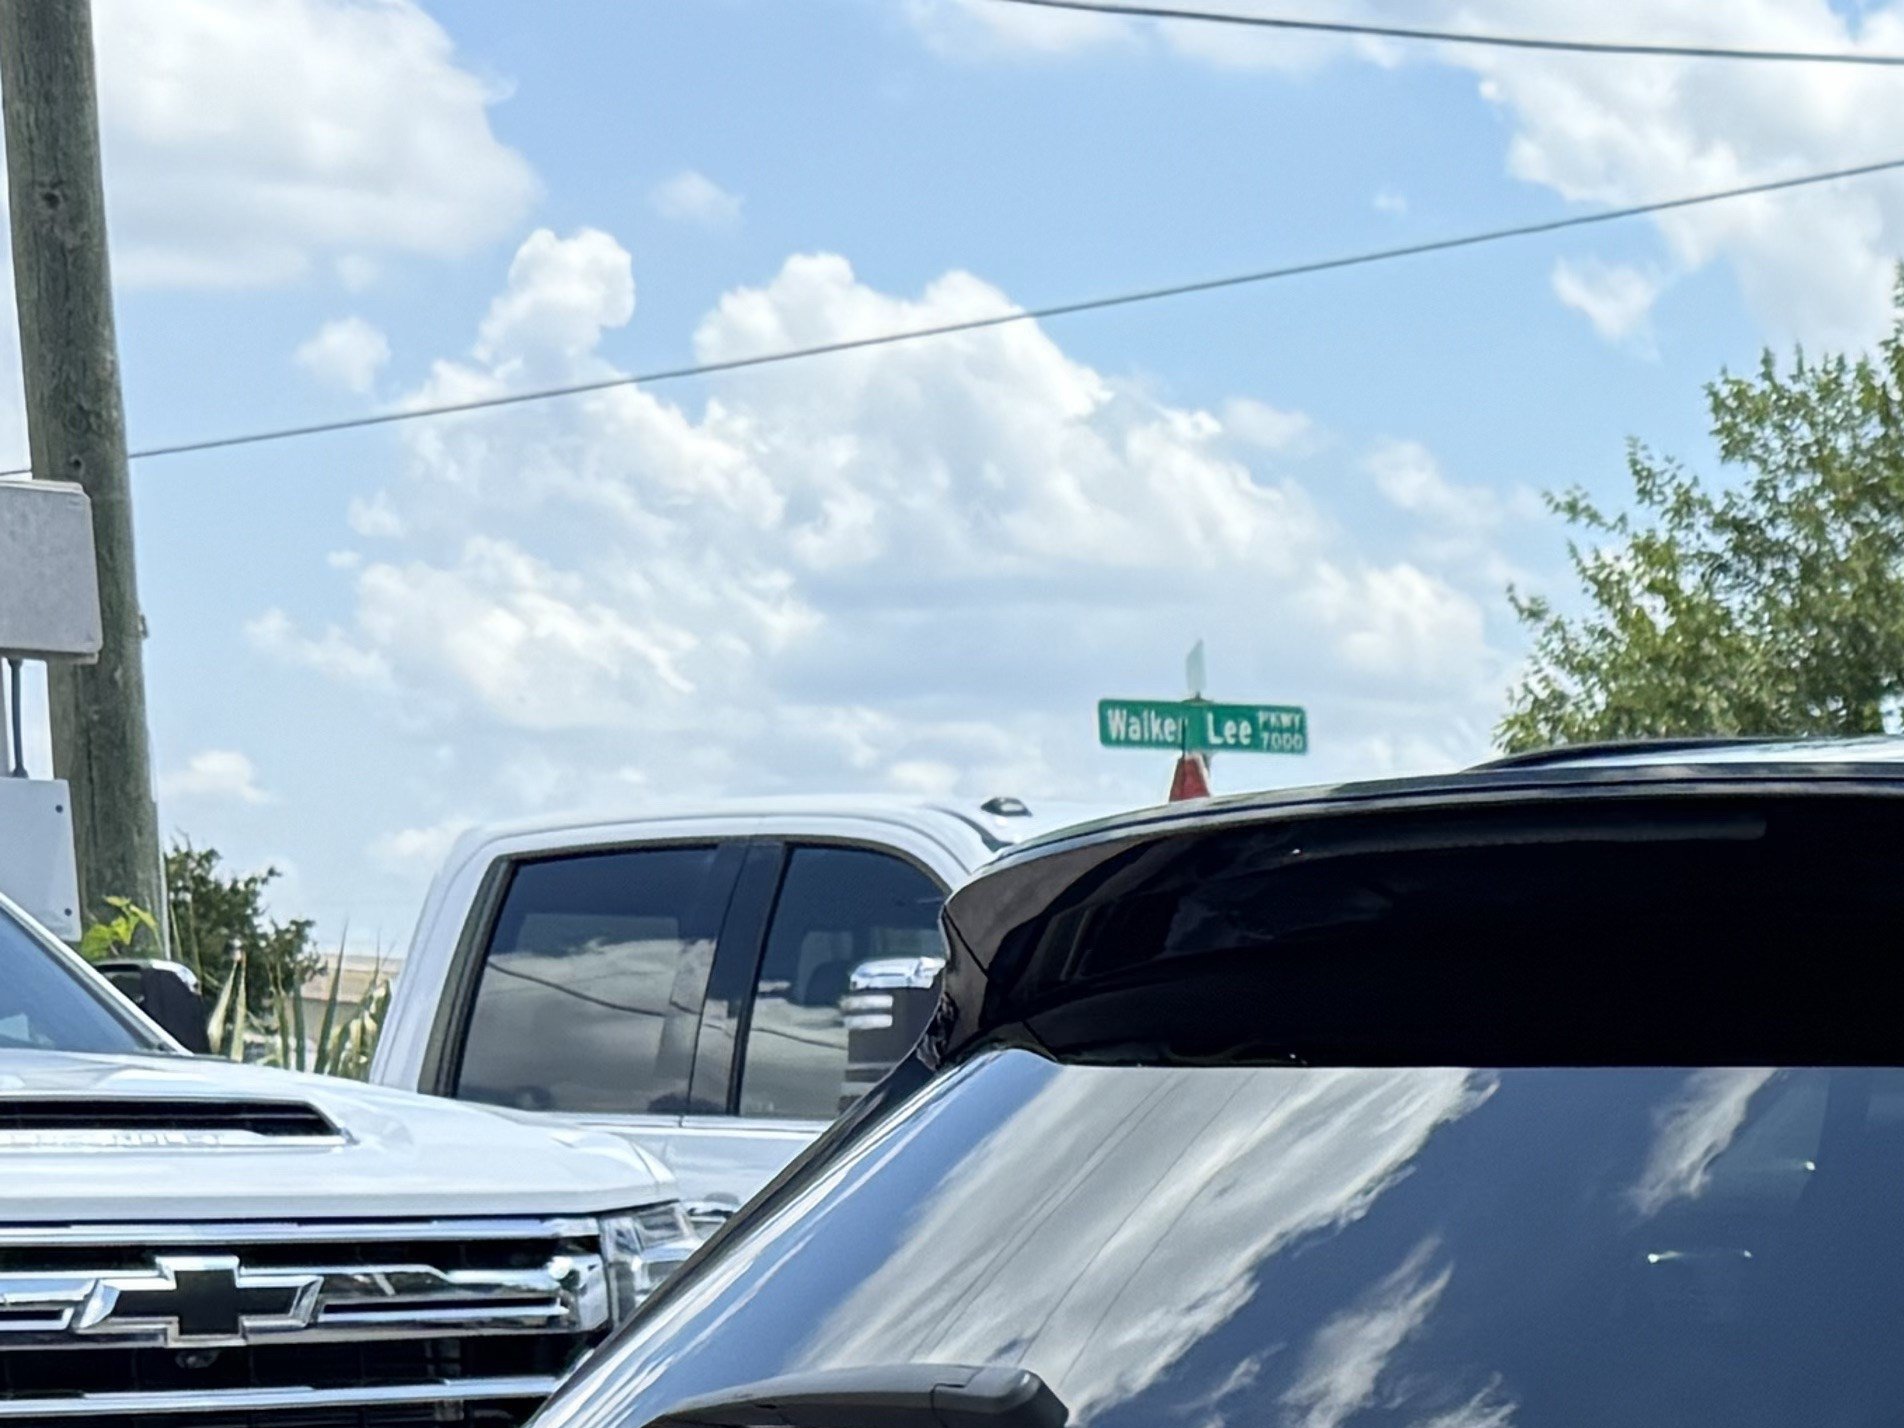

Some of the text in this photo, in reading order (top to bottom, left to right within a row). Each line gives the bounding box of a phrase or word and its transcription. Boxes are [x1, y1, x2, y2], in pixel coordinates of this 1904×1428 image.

[1107, 708, 1252, 745] Walker Lee
[1258, 711, 1301, 727] PKWY
[1261, 732, 1304, 750] 7000
